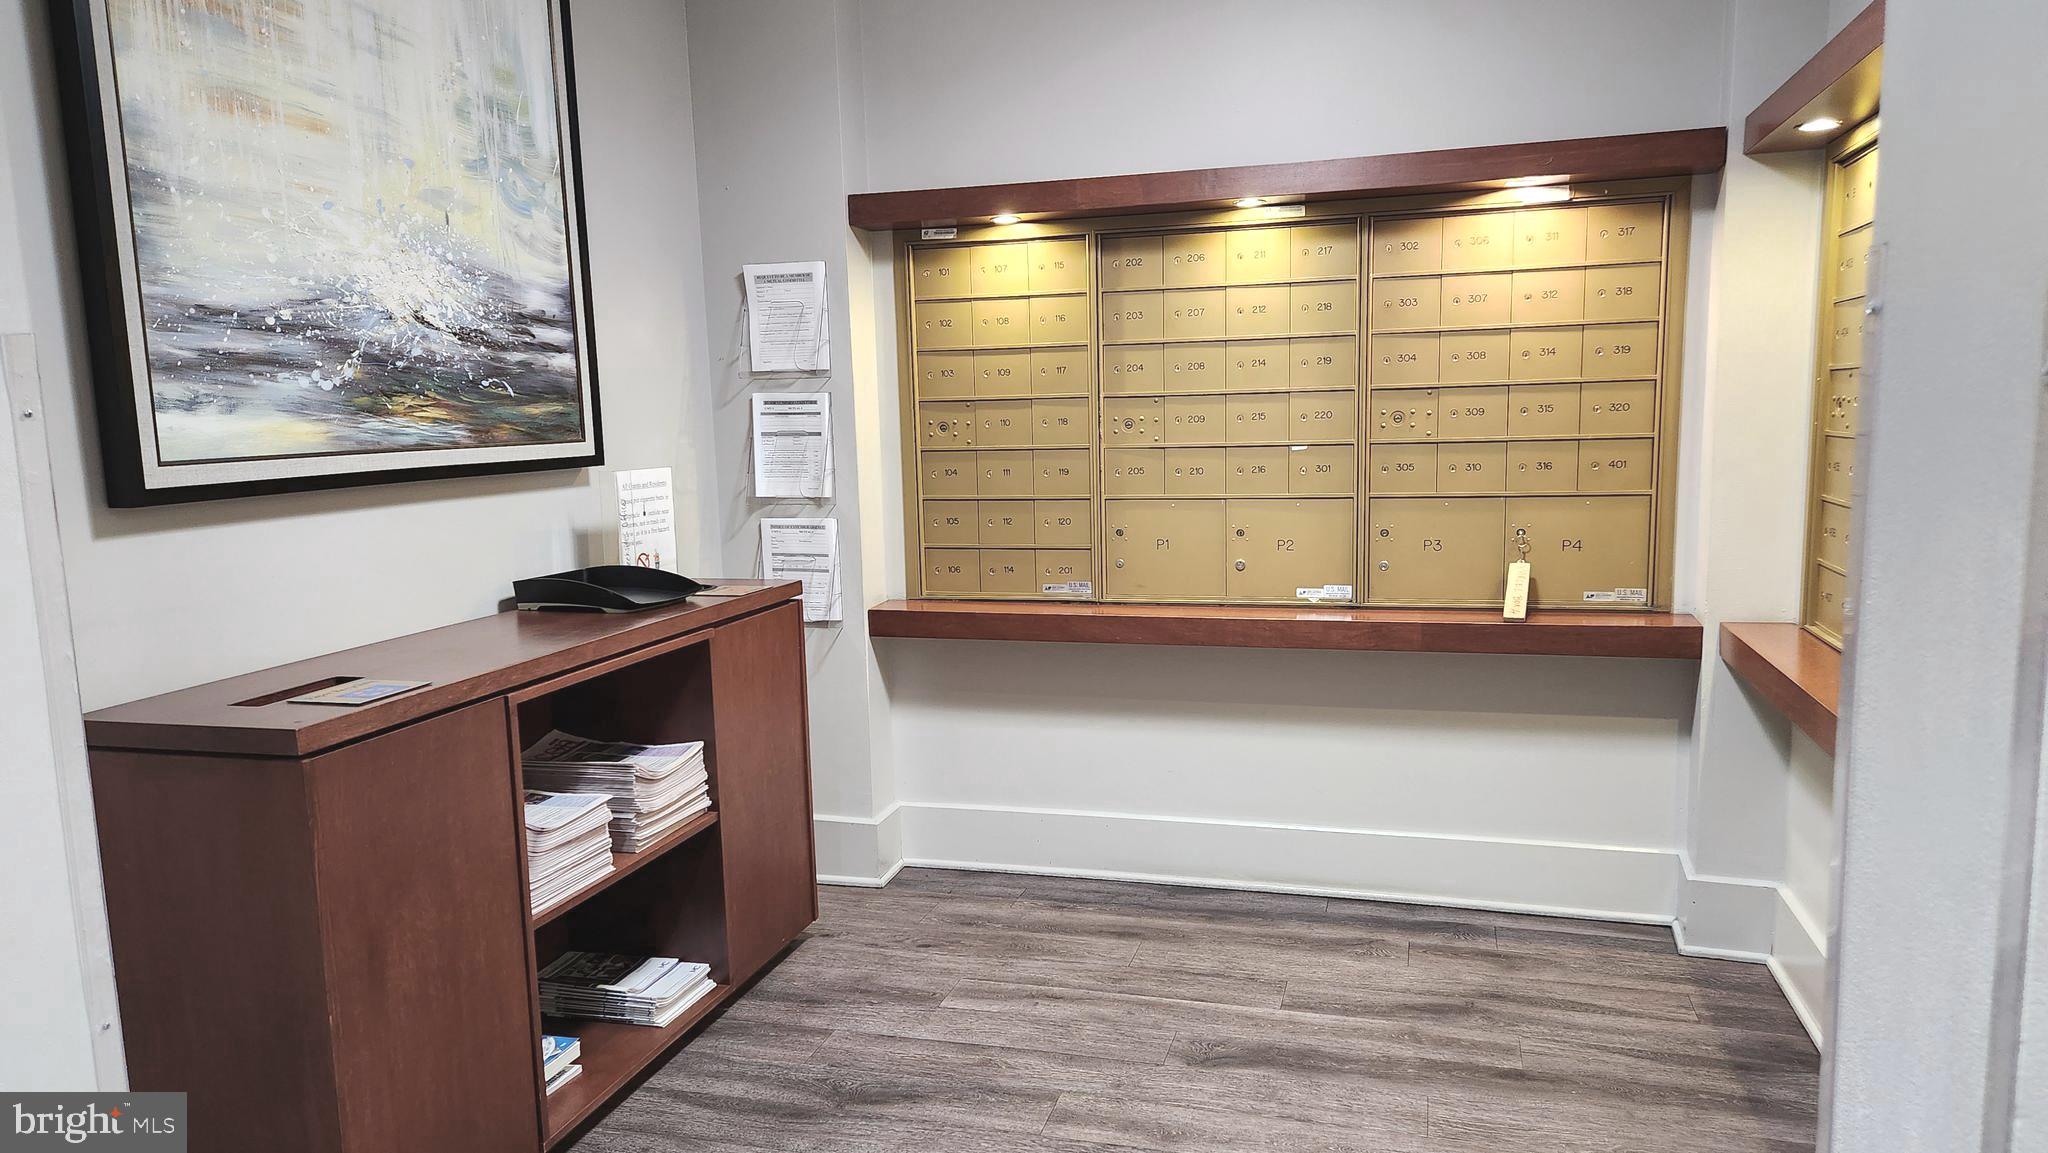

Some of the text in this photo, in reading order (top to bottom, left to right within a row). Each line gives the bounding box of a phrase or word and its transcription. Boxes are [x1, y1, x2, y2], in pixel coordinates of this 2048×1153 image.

[1618, 227, 1635, 236] 317
[1318, 246, 1333, 255] 217
[1400, 242, 1418, 251] 302
[1187, 254, 1205, 262] 206
[1254, 249, 1266, 259] 211
[1054, 261, 1064, 269] 115
[1126, 258, 1142, 266] 202
[939, 268, 950, 276] 101
[994, 265, 1007, 273] 107
[1542, 290, 1558, 299] 312
[1615, 286, 1632, 296] 318
[1399, 297, 1418, 307] 303
[1468, 294, 1487, 303] 307
[1252, 305, 1266, 313] 212
[1317, 302, 1332, 311] 218
[1126, 312, 1143, 320] 203
[1188, 308, 1204, 317] 207
[996, 317, 1009, 325] 108
[1055, 314, 1066, 322] 116
[1539, 347, 1556, 357] 314
[1613, 345, 1631, 354] 319
[1397, 354, 1416, 363] 304
[1466, 351, 1486, 360] 308
[1251, 359, 1265, 367] 214
[1316, 356, 1332, 365] 219
[1126, 364, 1143, 372] 204
[1188, 362, 1205, 370] 208
[941, 369, 954, 377] 103
[1465, 407, 1485, 417] 309
[1537, 404, 1553, 414] 315
[1609, 403, 1630, 412] 320
[1188, 415, 1205, 423] 209
[1251, 412, 1266, 421] 215
[1314, 411, 1333, 420] 220
[1058, 418, 1068, 426] 118
[1315, 465, 1331, 473] 301
[1395, 463, 1414, 472] 305
[1465, 463, 1481, 472] 310
[1536, 462, 1552, 471] 316
[1608, 460, 1627, 469] 401
[1128, 467, 1144, 475] 205
[1189, 467, 1203, 475] 210
[1251, 465, 1266, 474] 216
[1156, 539, 1169, 550] P1
[1277, 540, 1294, 551] P2
[1424, 540, 1442, 551] P3
[1562, 539, 1583, 551] P4
